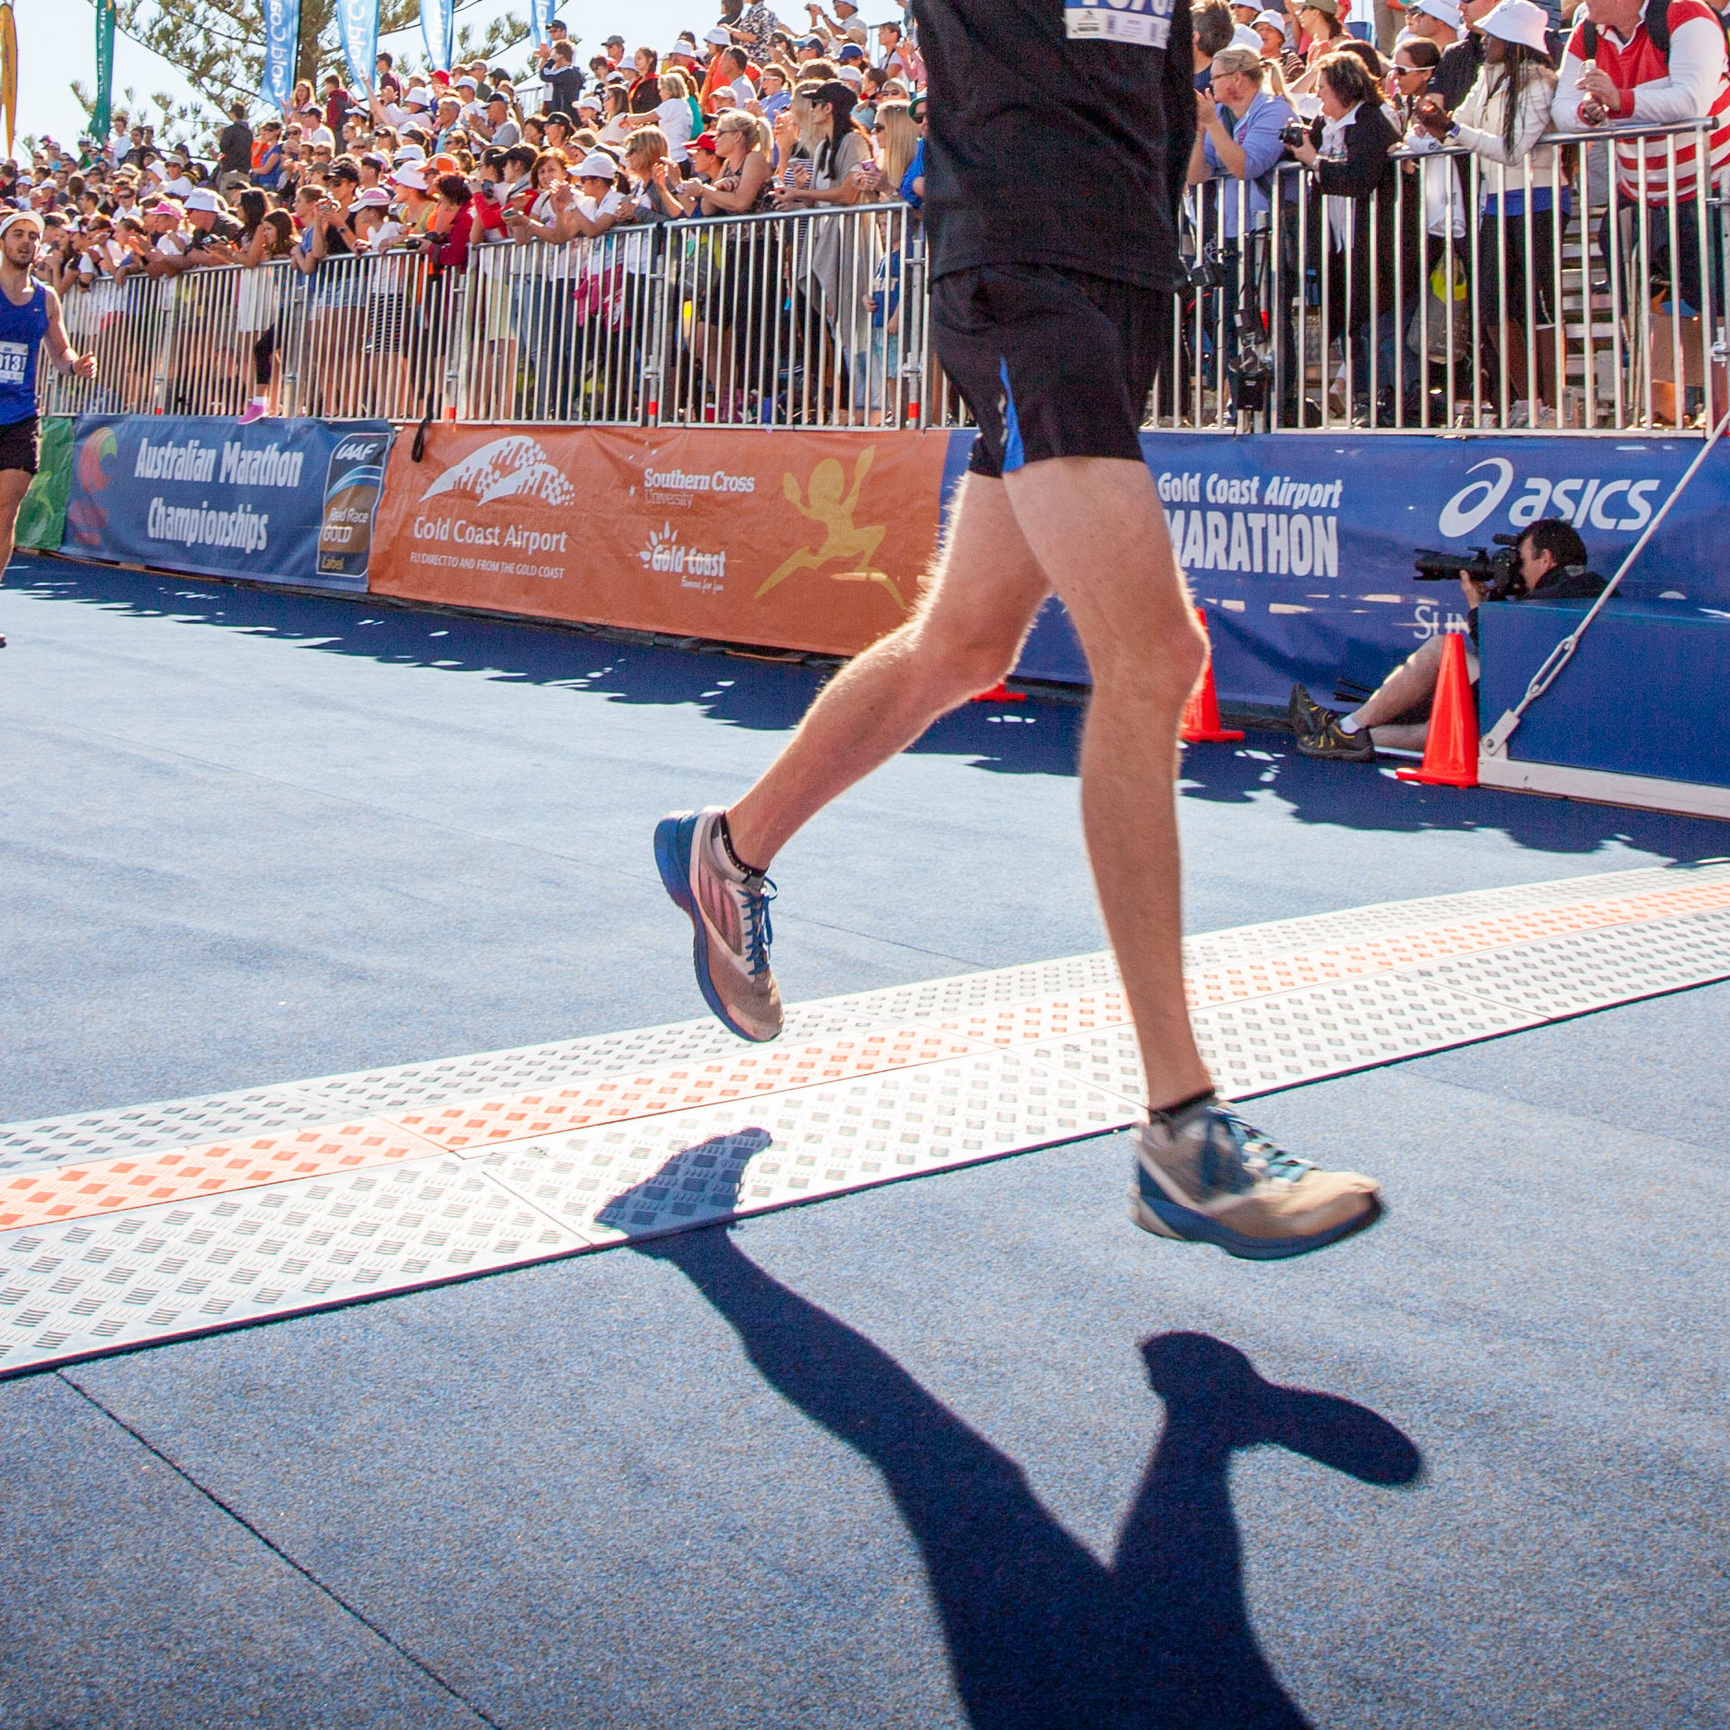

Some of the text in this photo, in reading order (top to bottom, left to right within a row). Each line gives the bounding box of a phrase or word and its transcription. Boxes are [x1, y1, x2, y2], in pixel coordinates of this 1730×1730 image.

[134, 438, 305, 488] Australian Marathon
[335, 442, 379, 461] IAAF
[644, 468, 756, 493] Southern Cross
[1157, 472, 1343, 510] Gold Coast Airport
[148, 497, 269, 554] Championships
[322, 525, 353, 545] GOLD
[413, 516, 569, 556] Gold Coast Airport
[652, 544, 686, 573] Gold
[1163, 509, 1339, 578] MARATHON
[516, 563, 537, 577] GOLD
[538, 566, 566, 580] COAST
